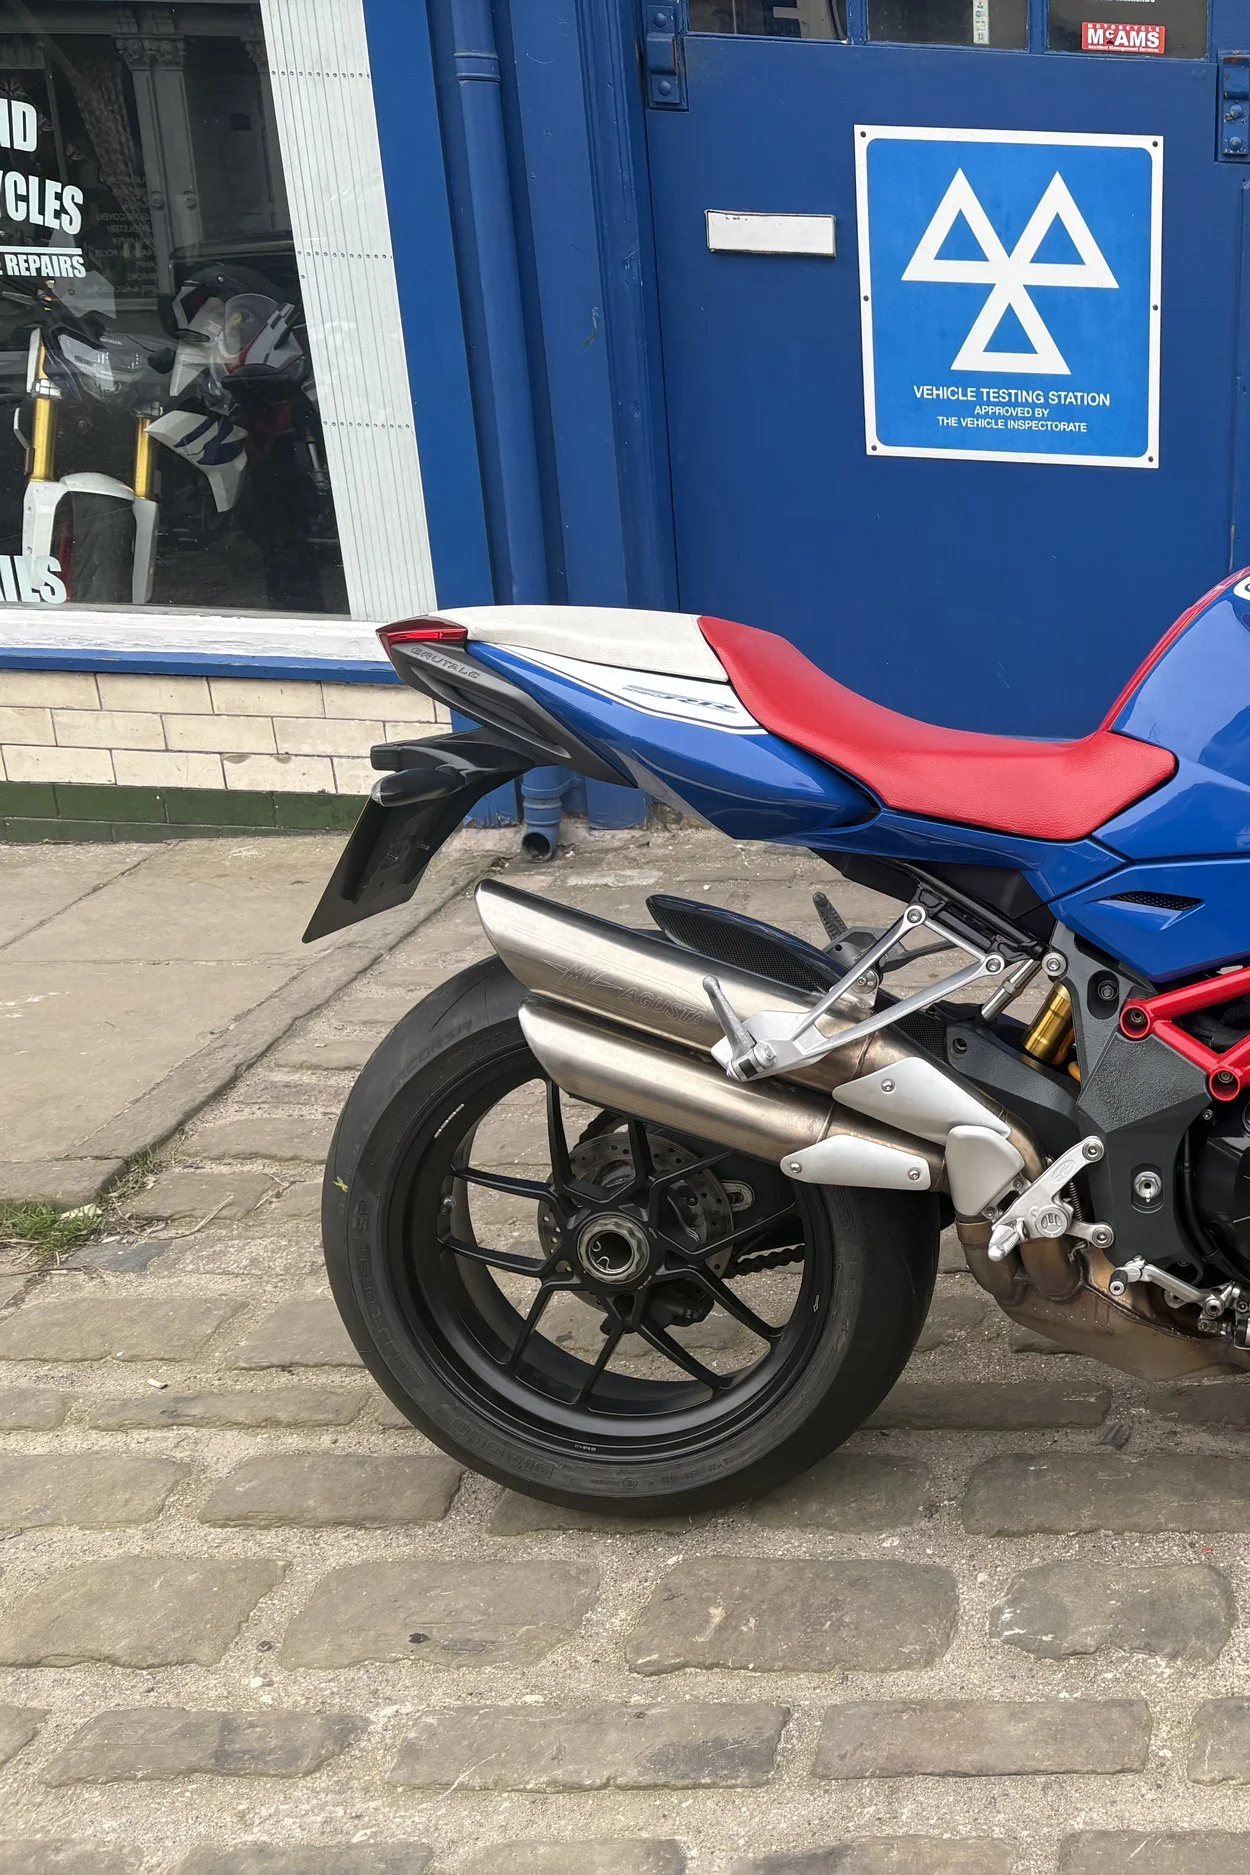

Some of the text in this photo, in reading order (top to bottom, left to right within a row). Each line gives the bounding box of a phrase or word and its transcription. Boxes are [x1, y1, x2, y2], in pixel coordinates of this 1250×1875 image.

[1088, 24, 1160, 32] MOTORCYCLE
[0, 170, 84, 235] CLES
[4, 253, 87, 278] REPAIRS
[913, 385, 1111, 406] VEHICLE TESTING STATION
[974, 405, 1050, 417] APPROVED BY
[937, 416, 1088, 432] THE VEHICLE INSPECTORATE
[410, 646, 481, 679] BRUTALE
[617, 986, 706, 1026] AGUSTA
